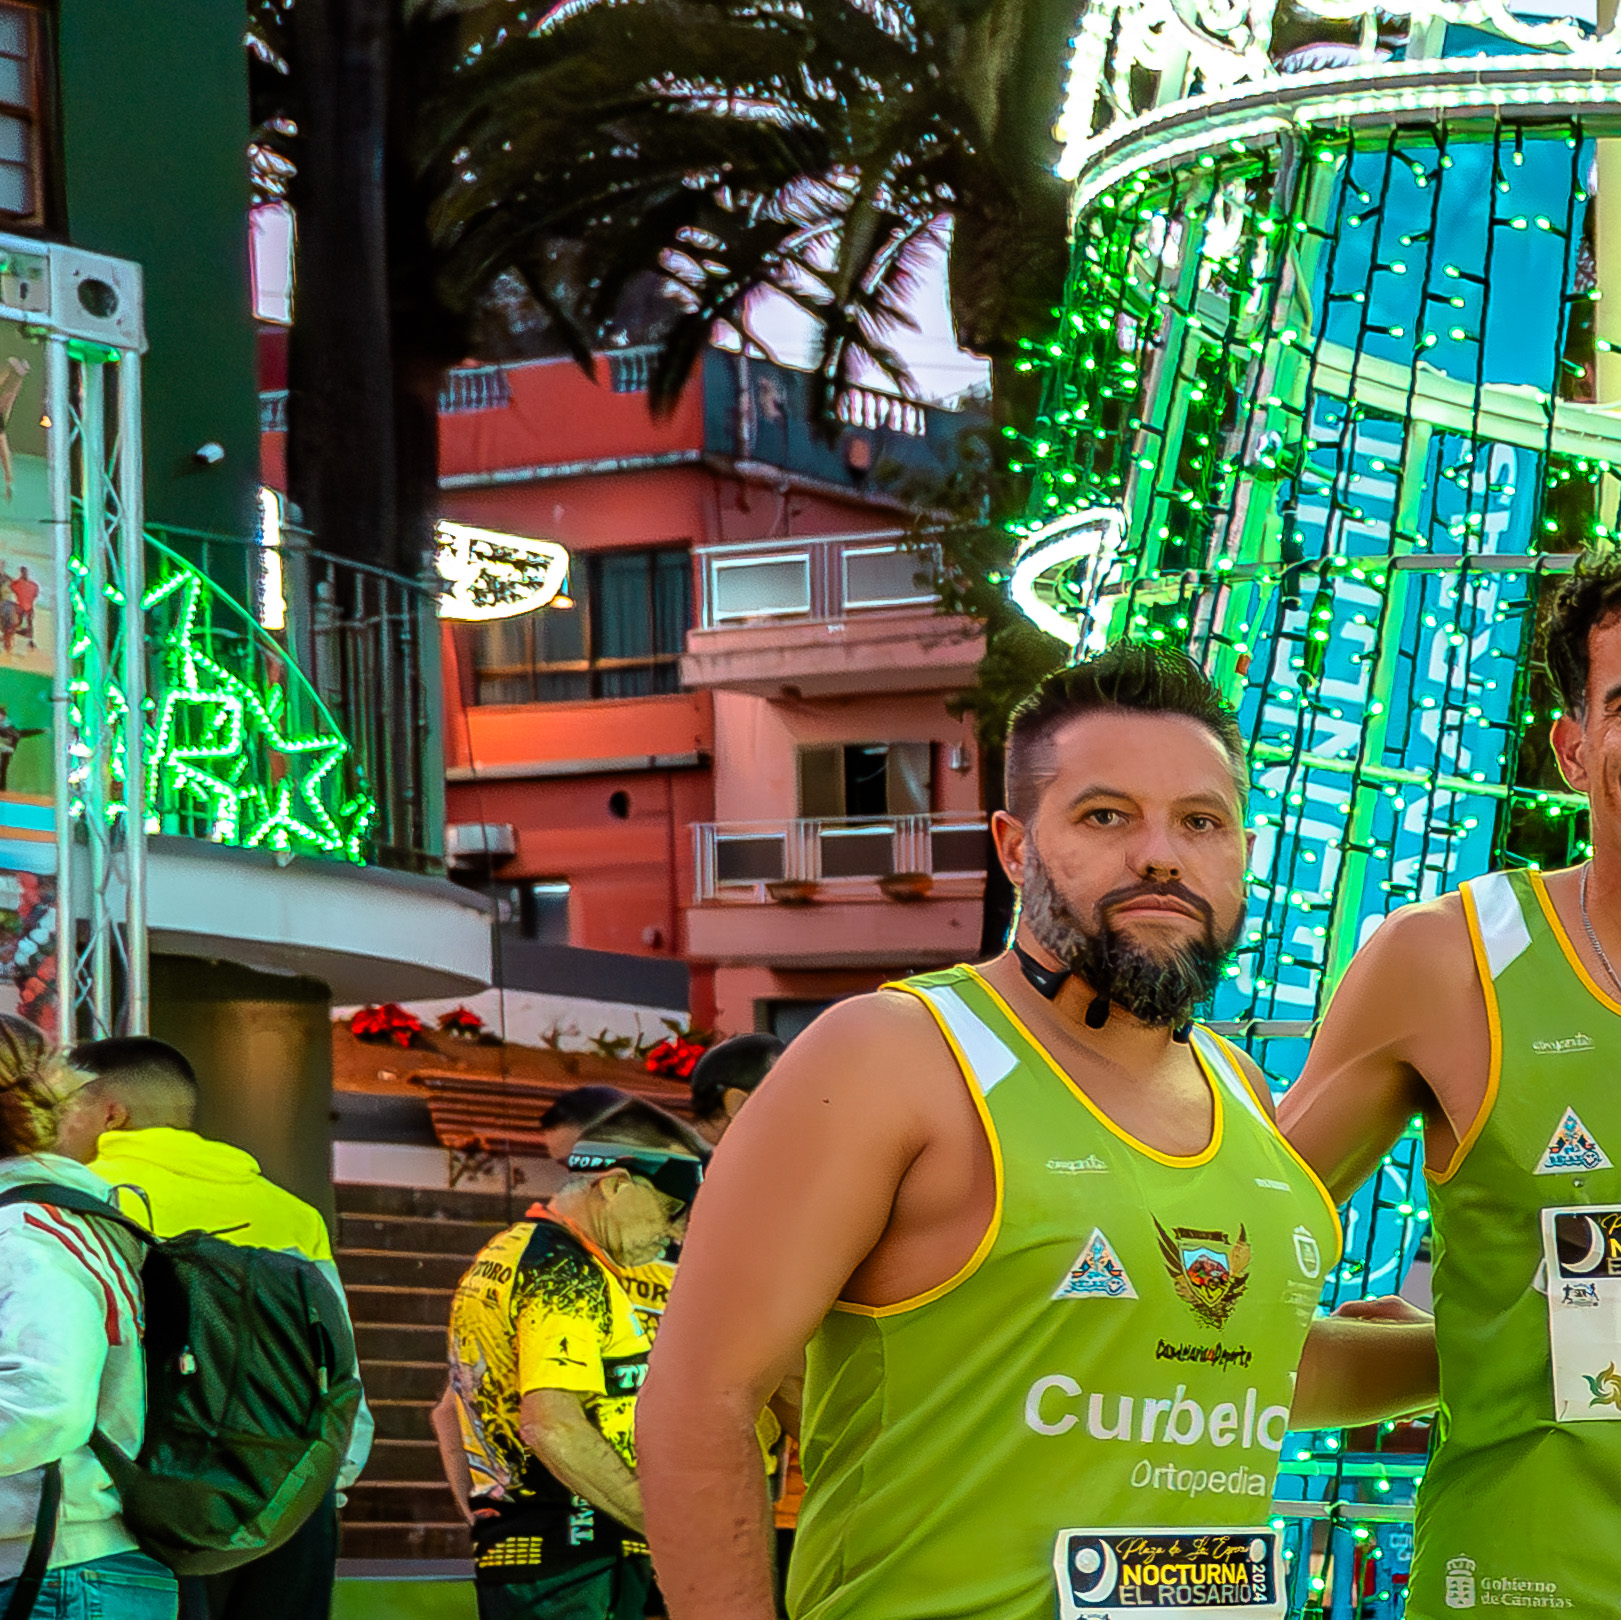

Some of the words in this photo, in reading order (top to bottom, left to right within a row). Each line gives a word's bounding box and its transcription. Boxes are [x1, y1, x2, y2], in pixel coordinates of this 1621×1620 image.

[1025, 1374, 1290, 1451] Curbelo
[1131, 1459, 1266, 1498] Ortopedia
[1122, 1564, 1248, 1585] NOCTURNA
[1251, 1564, 1267, 1602] 2024
[1480, 1577, 1557, 1593] Gobierno
[1119, 1584, 1152, 1605] EL
[1160, 1584, 1251, 1605] ROSARIO
